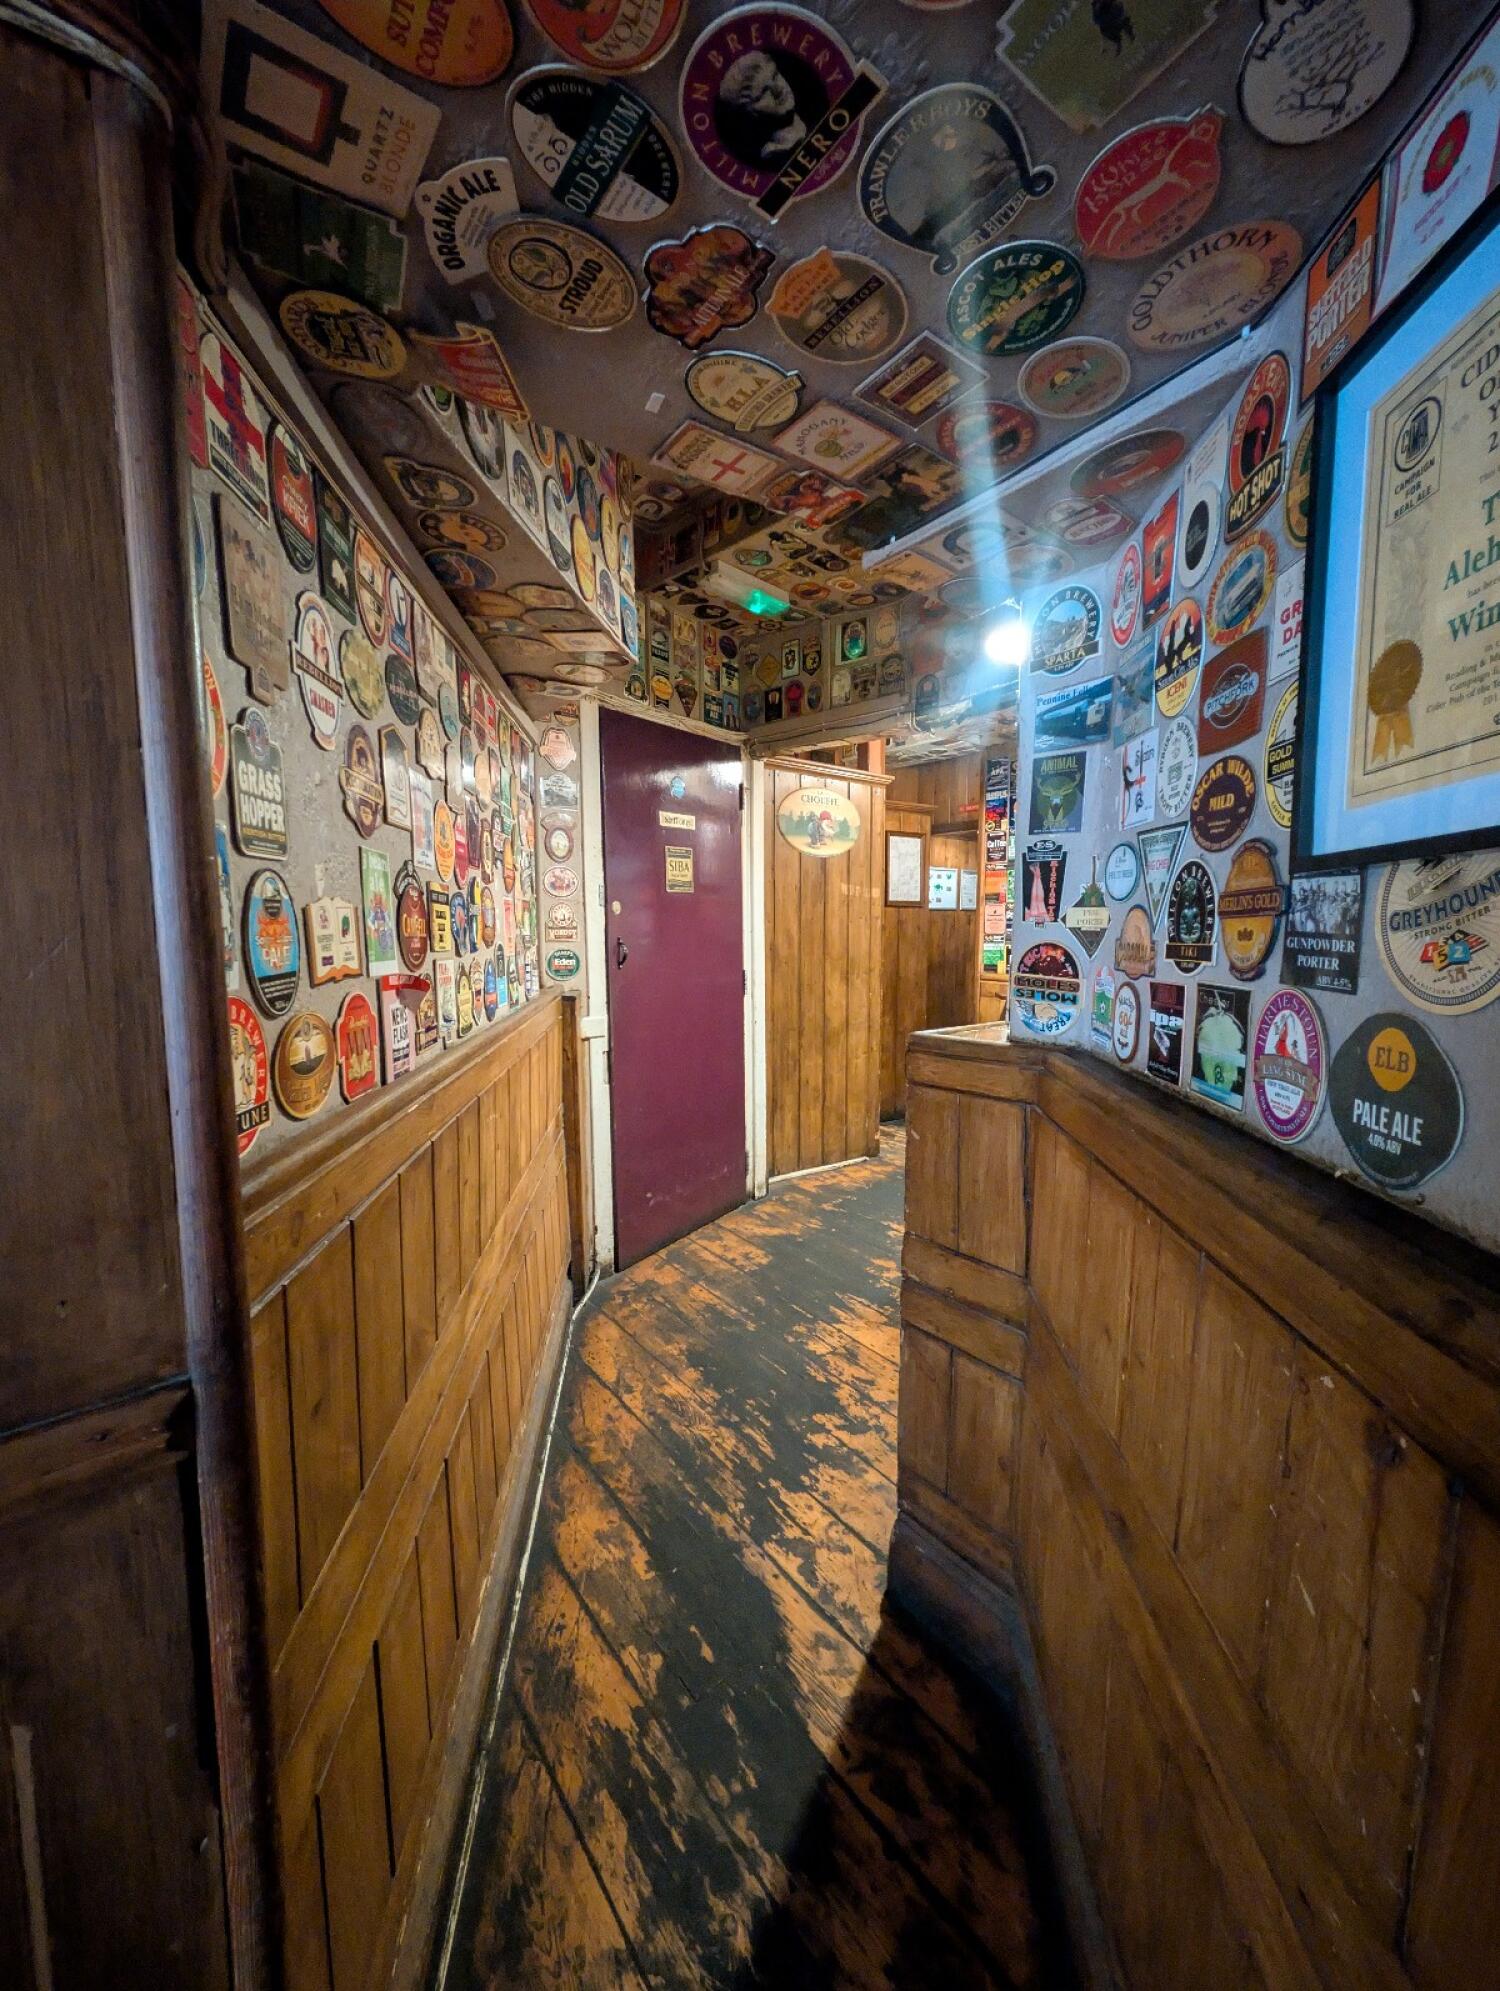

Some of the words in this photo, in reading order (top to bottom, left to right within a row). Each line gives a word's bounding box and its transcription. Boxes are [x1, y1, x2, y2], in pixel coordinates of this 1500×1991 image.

[706, 22, 844, 83] BREWERY
[361, 106, 395, 186] QUARTZ
[691, 82, 760, 191] MILTON
[780, 108, 850, 191] NERO
[564, 171, 602, 214] OLD
[584, 94, 645, 177] SARUM
[432, 184, 470, 271] ORGANIC
[459, 169, 502, 203] ALE
[992, 253, 1044, 272] ALES
[559, 258, 604, 316] STROUD
[1131, 228, 1279, 332] GOLDTHORN
[1229, 489, 1250, 522] HOT
[1251, 458, 1281, 506] SHOT
[1395, 456, 1436, 494] CAMPAIGN
[1405, 480, 1422, 499] FOR
[1394, 498, 1415, 519] REAL
[1416, 485, 1432, 503] ALE
[1065, 589, 1098, 638] BREWERY
[1044, 647, 1086, 668] SPARTA
[1206, 675, 1256, 712] PITCHFORK
[1041, 755, 1079, 774] ANIMAL
[1269, 745, 1292, 762] GOLD
[238, 760, 282, 801] GRASS
[1192, 761, 1225, 811] OSCAR
[1227, 758, 1256, 798] WILDE
[239, 793, 286, 833] HOPPER
[1209, 793, 1236, 812] MILD
[668, 859, 690, 873] SIBA
[1169, 869, 1188, 938] MILTON
[1191, 865, 1214, 941] BREWERY
[1254, 892, 1280, 908] GOLD
[1389, 870, 1500, 931] GREYHOUN
[1414, 921, 1453, 939] STRONG
[1455, 905, 1491, 926] BITTER
[1181, 945, 1198, 958] TIKI
[1286, 936, 1356, 953] GUNPOWDER
[1454, 945, 1465, 959] 2
[553, 957, 576, 967] Eden
[1296, 955, 1340, 971] PORTER
[1015, 975, 1078, 992] MOLES
[1015, 988, 1079, 1004] MOLES
[1316, 976, 1333, 986] ABV
[391, 1005, 409, 1027] NEWS
[1038, 1013, 1071, 1033] TREAT
[1256, 992, 1319, 1059] HARVIESTOUN
[229, 1004, 266, 1097] BREWERY
[392, 1024, 410, 1048] FLASH
[1374, 1047, 1409, 1073] ELB
[1352, 1098, 1390, 1134] PALE
[1391, 1111, 1424, 1146] ALE
[1386, 1140, 1402, 1156] ABV
